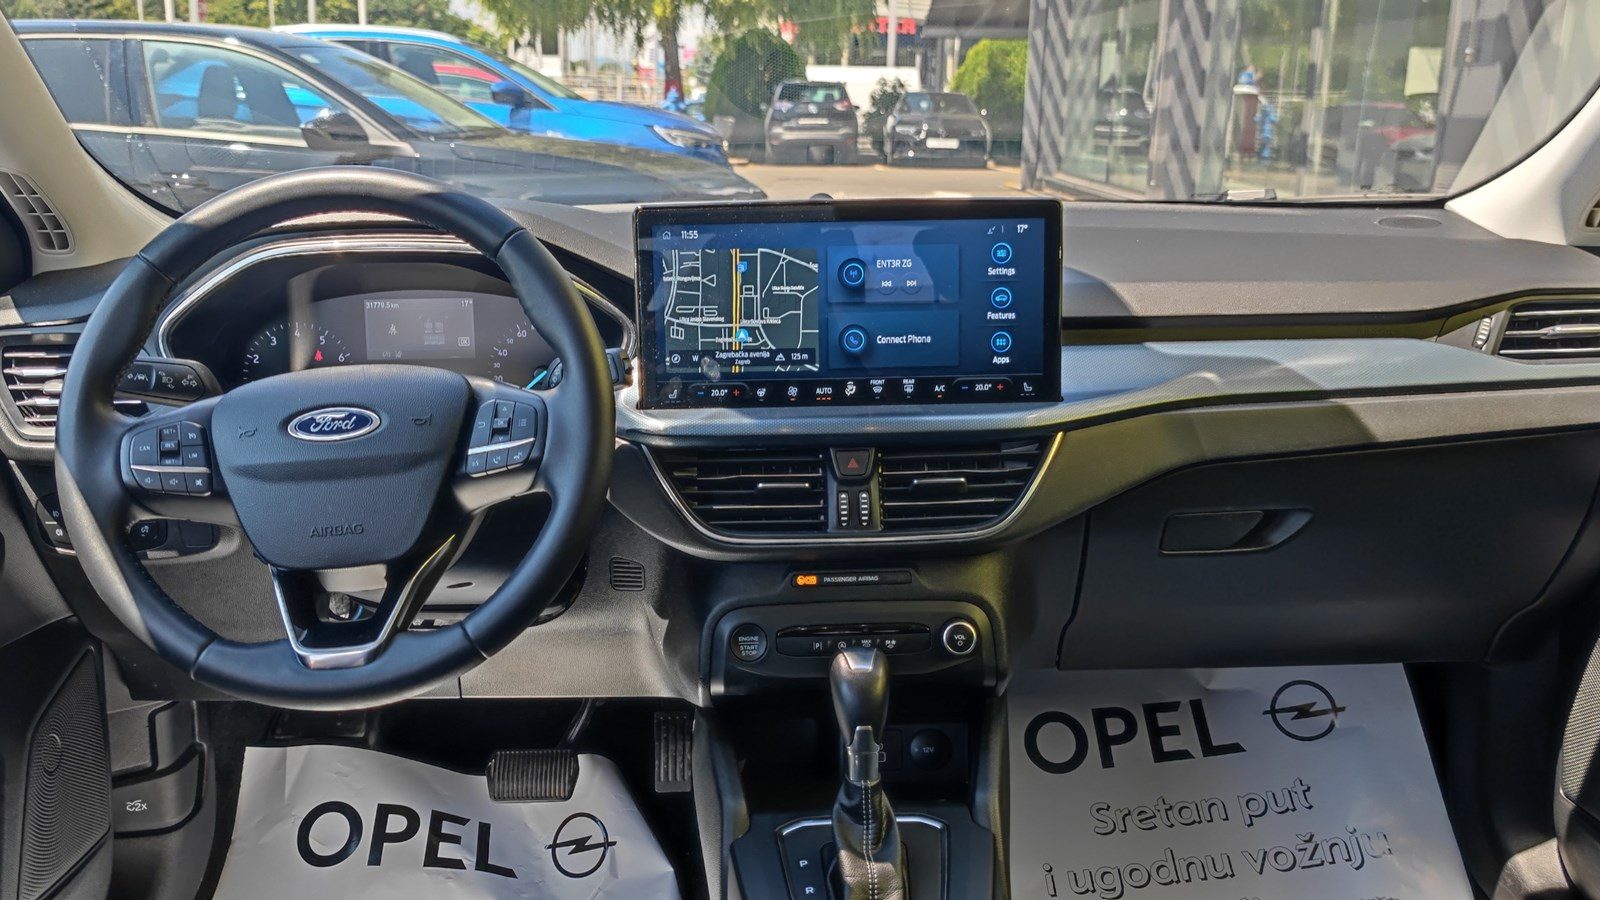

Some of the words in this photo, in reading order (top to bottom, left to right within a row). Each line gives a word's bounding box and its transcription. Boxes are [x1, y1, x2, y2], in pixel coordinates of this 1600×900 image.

[681, 230, 698, 238] 11:55
[876, 260, 901, 268] ENT3R
[902, 260, 912, 268] ZG
[987, 267, 1016, 277] Settings
[987, 312, 1016, 320] Features
[294, 328, 300, 337] 4
[270, 336, 277, 346] 3
[320, 336, 326, 345] 5
[876, 336, 907, 344] Connect
[908, 335, 931, 343] Phone
[253, 354, 260, 364] 2
[338, 353, 345, 362] 6
[715, 351, 748, 359] Zagrebačka
[992, 356, 1010, 365] Apps
[310, 412, 357, 433] Ford
[310, 523, 364, 538] AIRBAG
[1024, 699, 1247, 774] OPEL
[1090, 794, 1229, 835] Sretan
[1236, 777, 1315, 827] put
[297, 801, 518, 879] OPEL
[1042, 862, 1057, 897] i
[1067, 847, 1236, 900] ugodnu
[1241, 825, 1392, 875] vožnju
